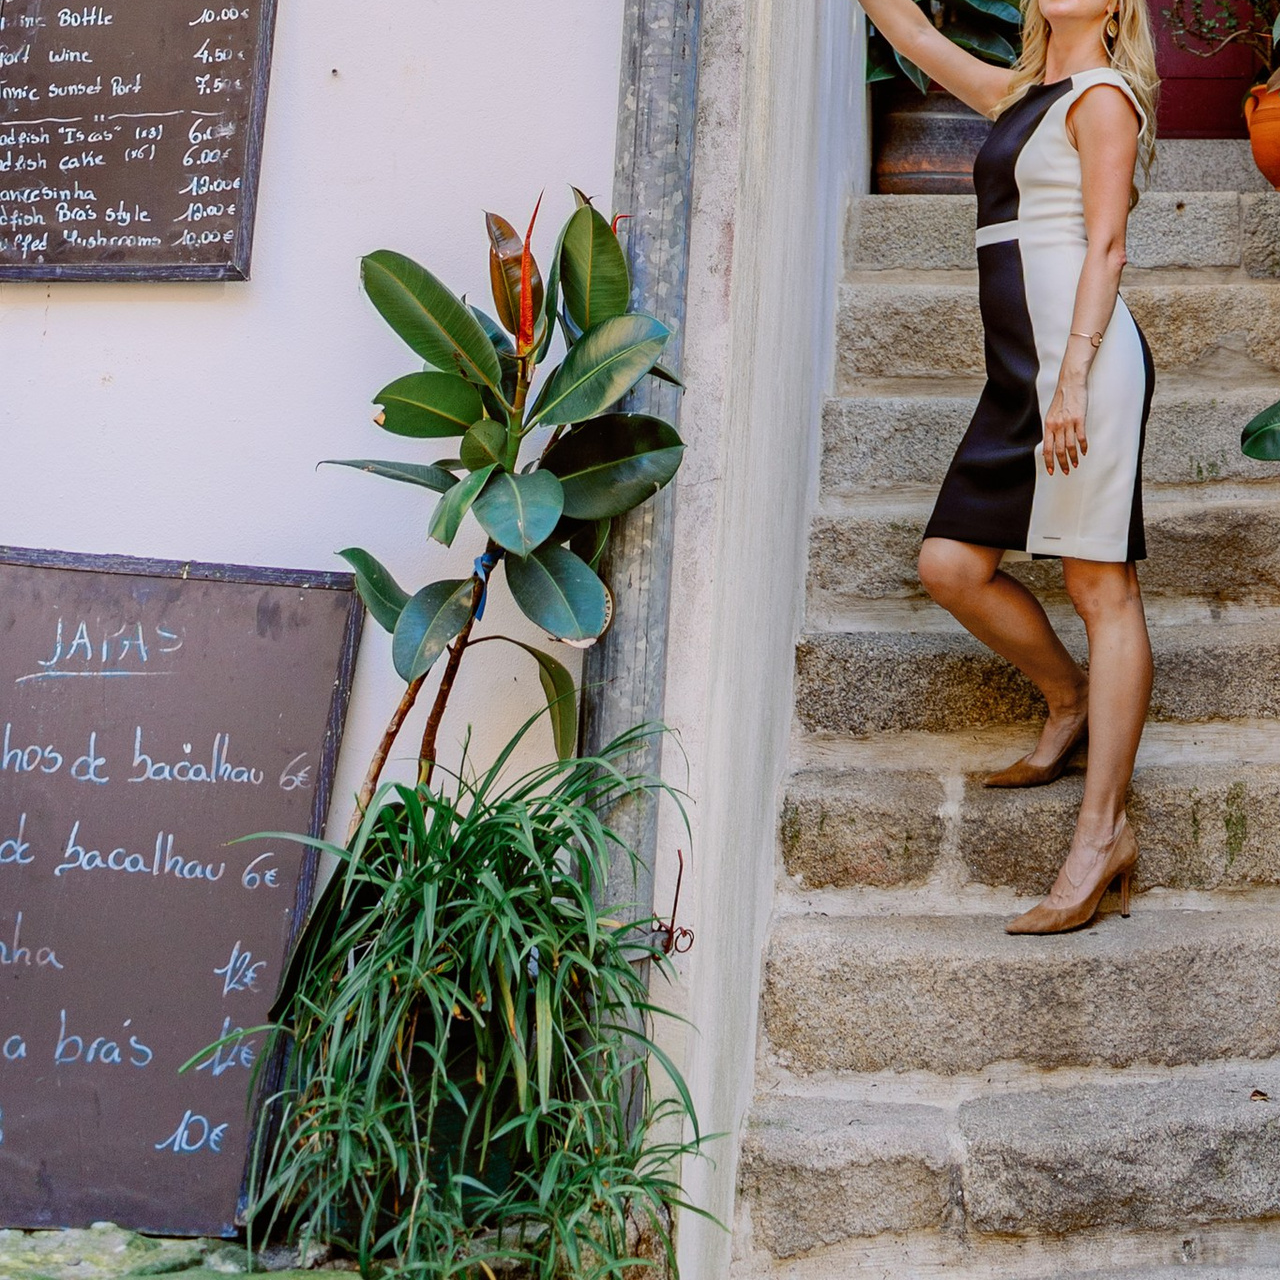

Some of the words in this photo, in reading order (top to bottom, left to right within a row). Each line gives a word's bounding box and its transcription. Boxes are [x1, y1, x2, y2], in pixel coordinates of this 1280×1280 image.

[110, 73, 142, 97] Port
[54, 820, 226, 881] bacalhau
[241, 852, 281, 889] 6€
[155, 1109, 229, 1153] 10€
